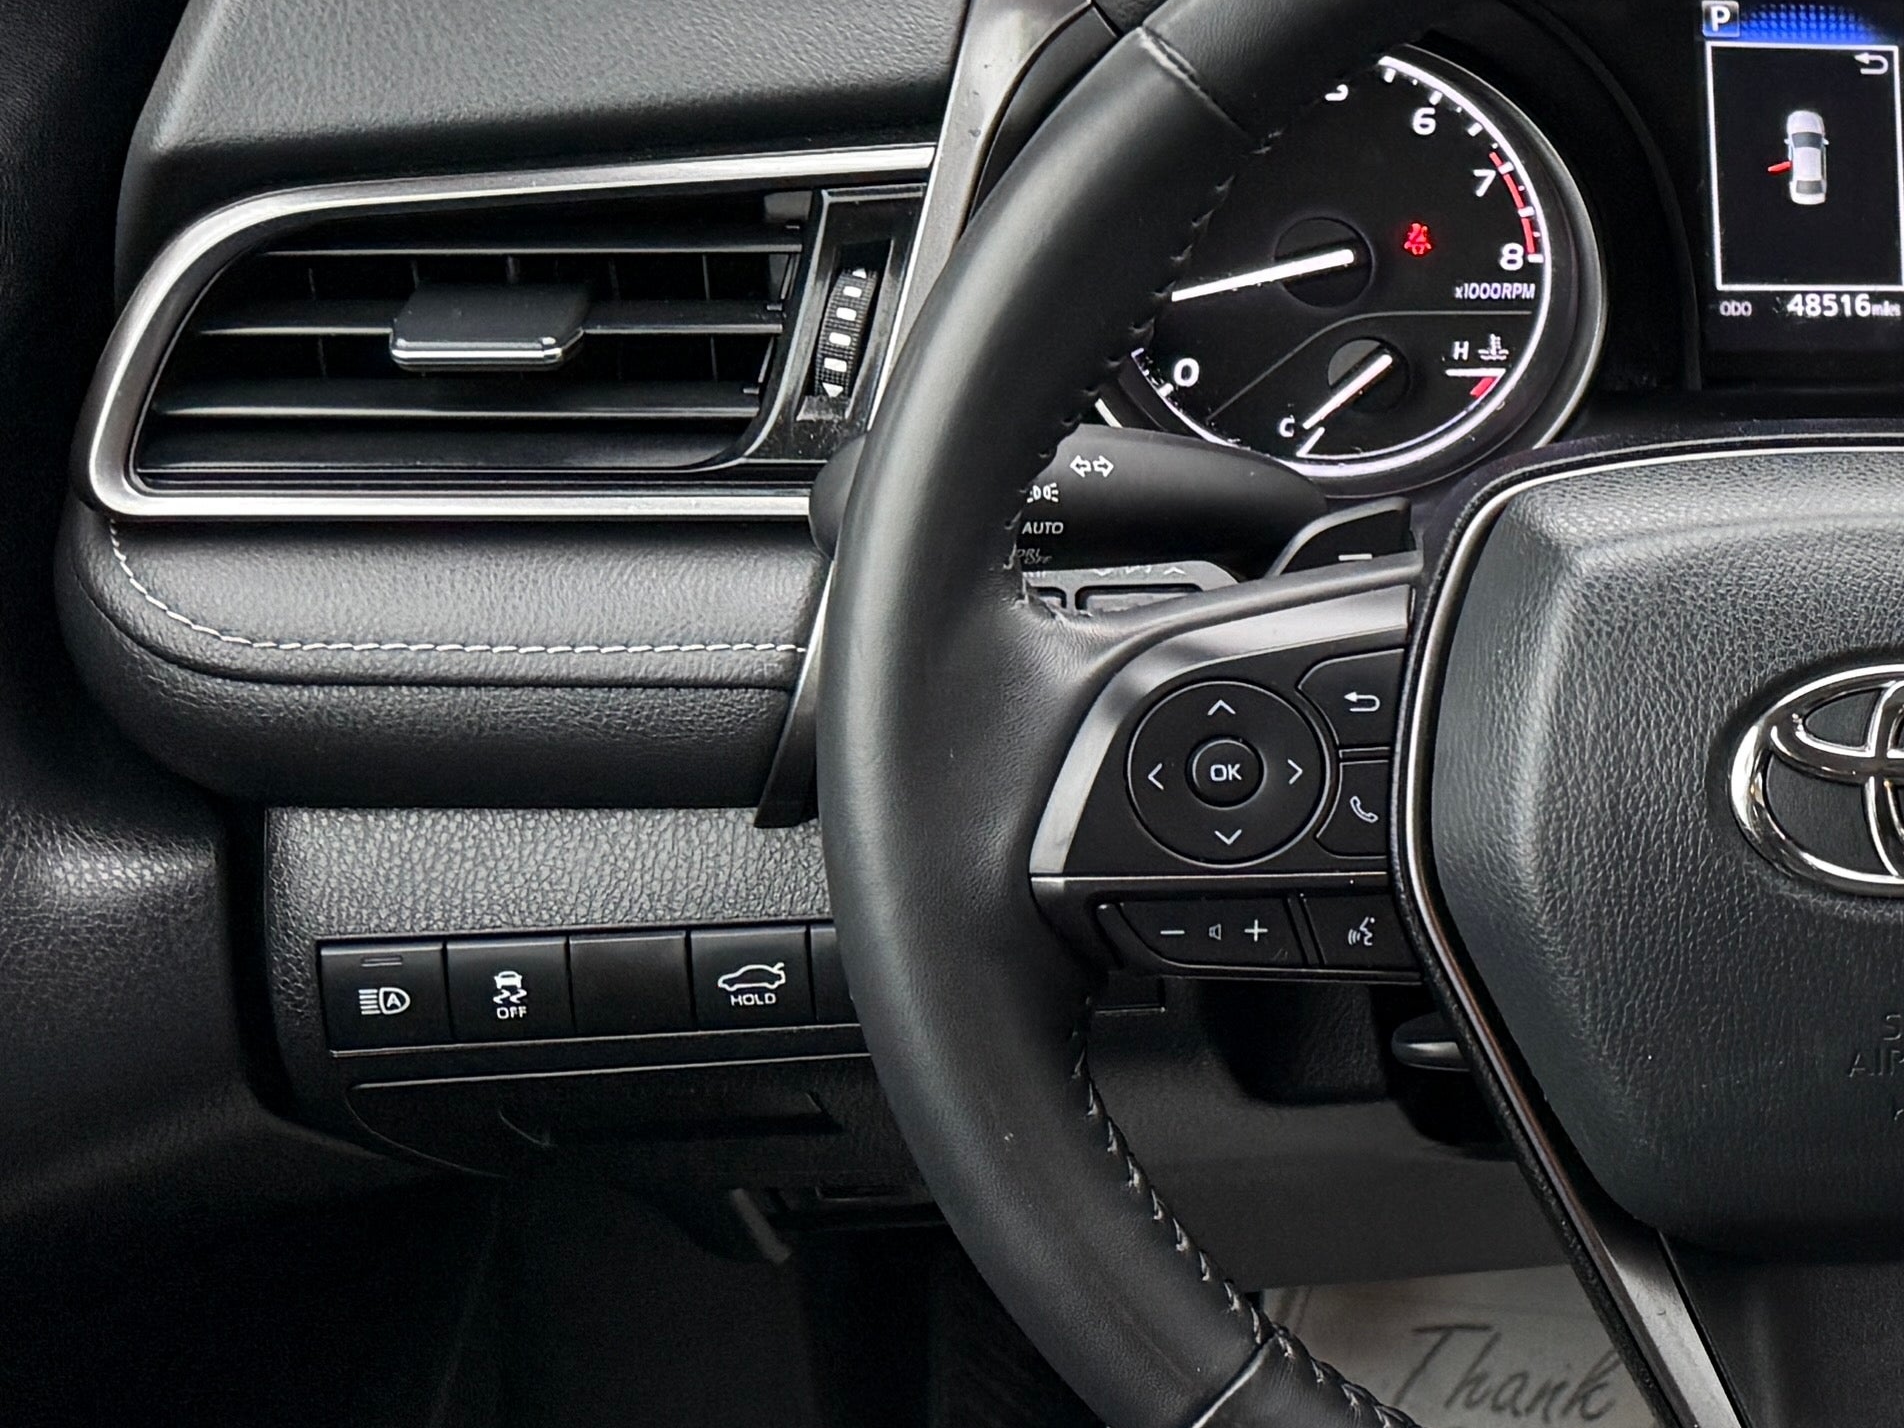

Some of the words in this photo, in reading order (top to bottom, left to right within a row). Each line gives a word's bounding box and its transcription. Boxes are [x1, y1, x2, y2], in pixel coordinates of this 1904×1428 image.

[1710, 6, 1730, 31] P
[1413, 108, 1436, 135] 6
[1473, 169, 1496, 197] 7
[1500, 243, 1524, 270] 8
[1719, 301, 1752, 317] ODO
[1786, 293, 1871, 318] 48516
[1453, 341, 1469, 360] H
[1173, 357, 1200, 388] 0
[1021, 521, 1064, 535] AUTO
[1210, 763, 1242, 782] OK
[496, 1005, 528, 1020] OFF
[730, 993, 777, 1007] HOLD
[1395, 1324, 1623, 1423] Thank
